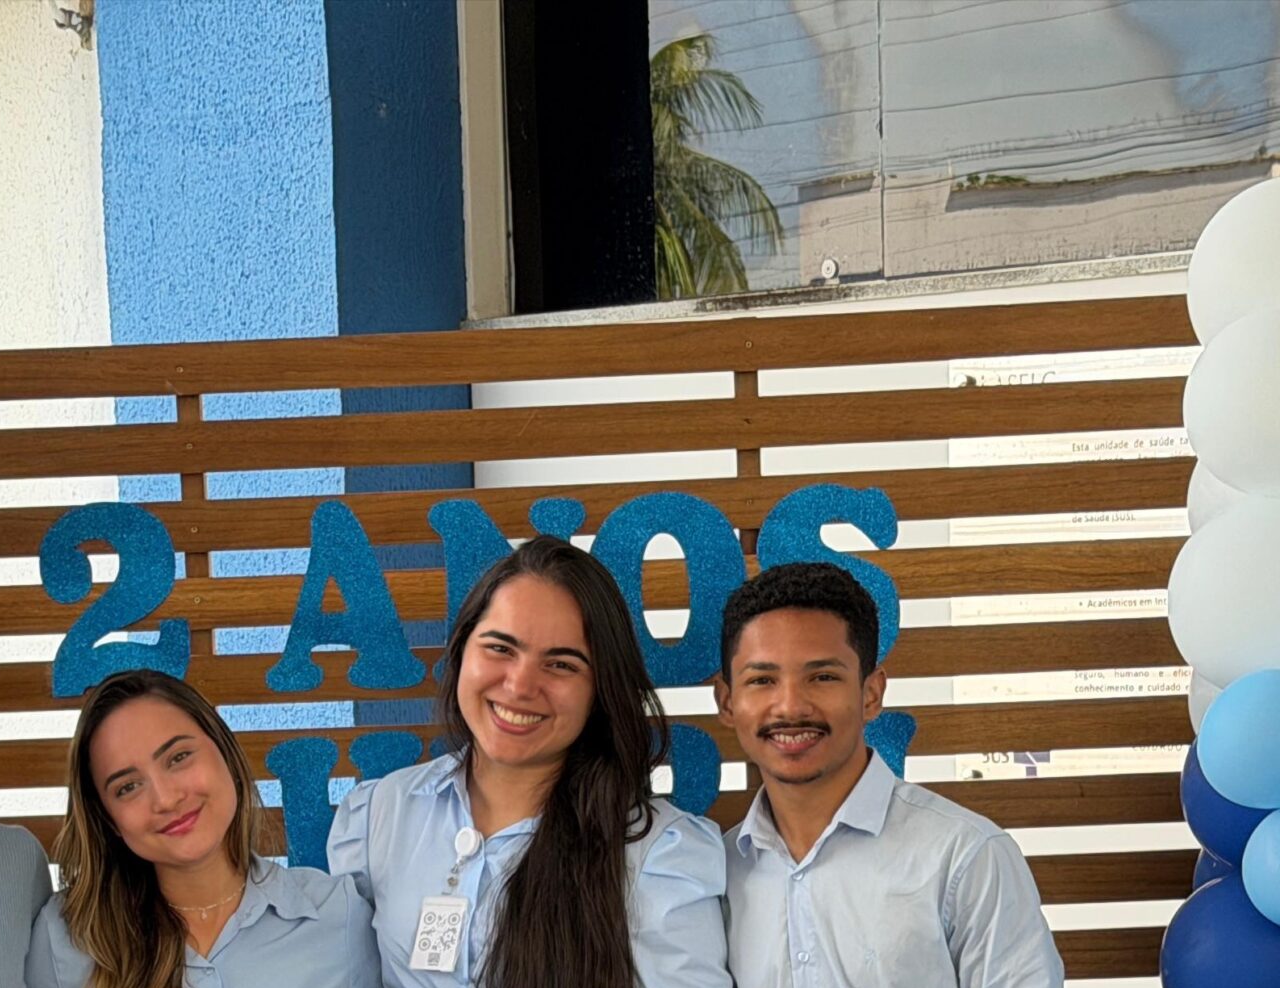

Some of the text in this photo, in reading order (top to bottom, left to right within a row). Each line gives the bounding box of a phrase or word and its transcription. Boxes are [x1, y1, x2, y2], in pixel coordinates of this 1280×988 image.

[1071, 442, 1090, 453] Esta
[1094, 440, 1130, 451] unidade
[1133, 438, 1145, 449] de
[1149, 436, 1175, 448] saúde
[39, 501, 190, 698] 2
[1087, 598, 1138, 609] Acadêmicos
[1139, 599, 1153, 607] em
[1113, 668, 1150, 679] humano
[1074, 683, 1135, 694] conhecimento
[1147, 682, 1181, 693] cuidado
